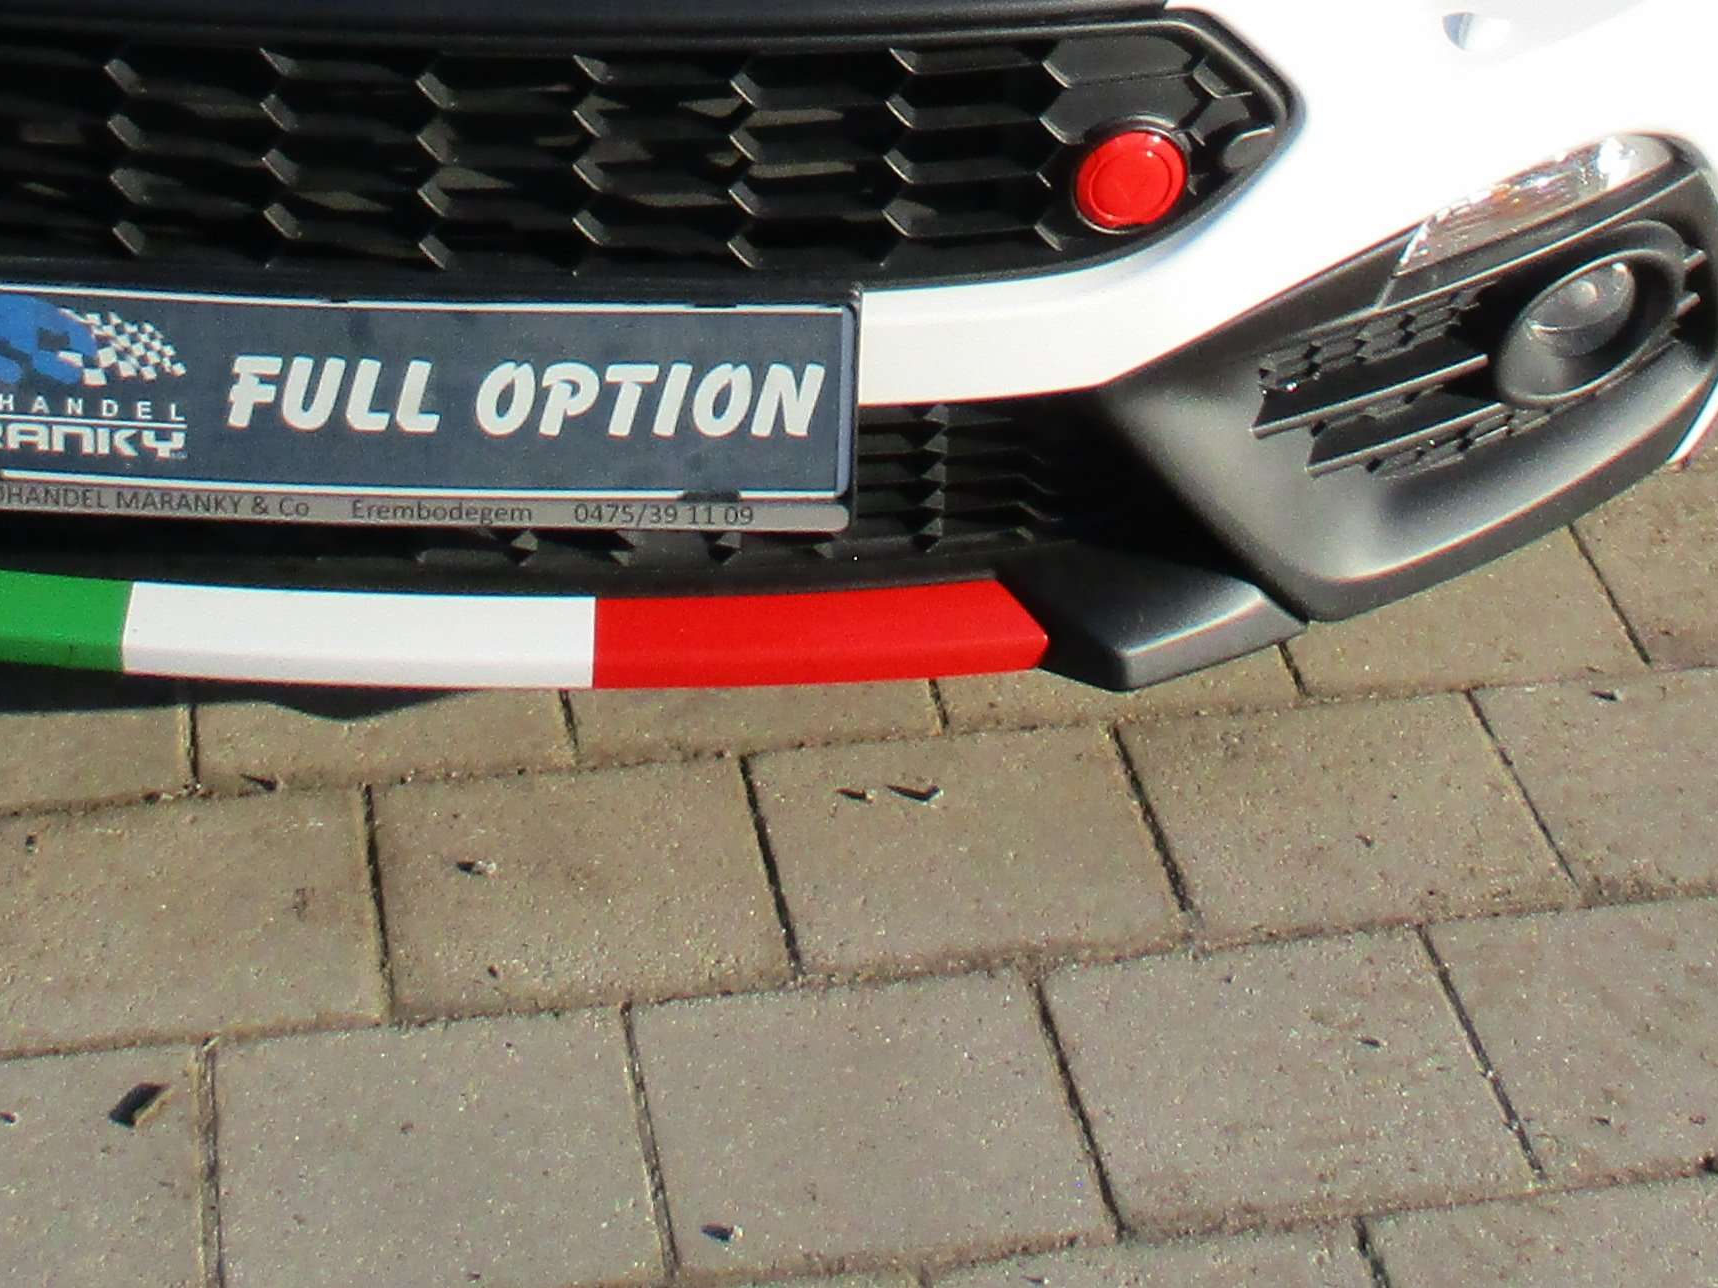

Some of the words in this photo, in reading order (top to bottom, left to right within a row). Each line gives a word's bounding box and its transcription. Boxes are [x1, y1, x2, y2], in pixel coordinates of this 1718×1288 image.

[227, 354, 442, 434] FULL
[475, 361, 827, 438] OPTION
[115, 489, 242, 516] MARANKY
[249, 490, 271, 516] &
[278, 497, 311, 518] Co
[350, 499, 533, 526] Erembodegem
[573, 501, 679, 526] 0475/39
[687, 503, 715, 525] 11
[723, 503, 755, 526] 09
